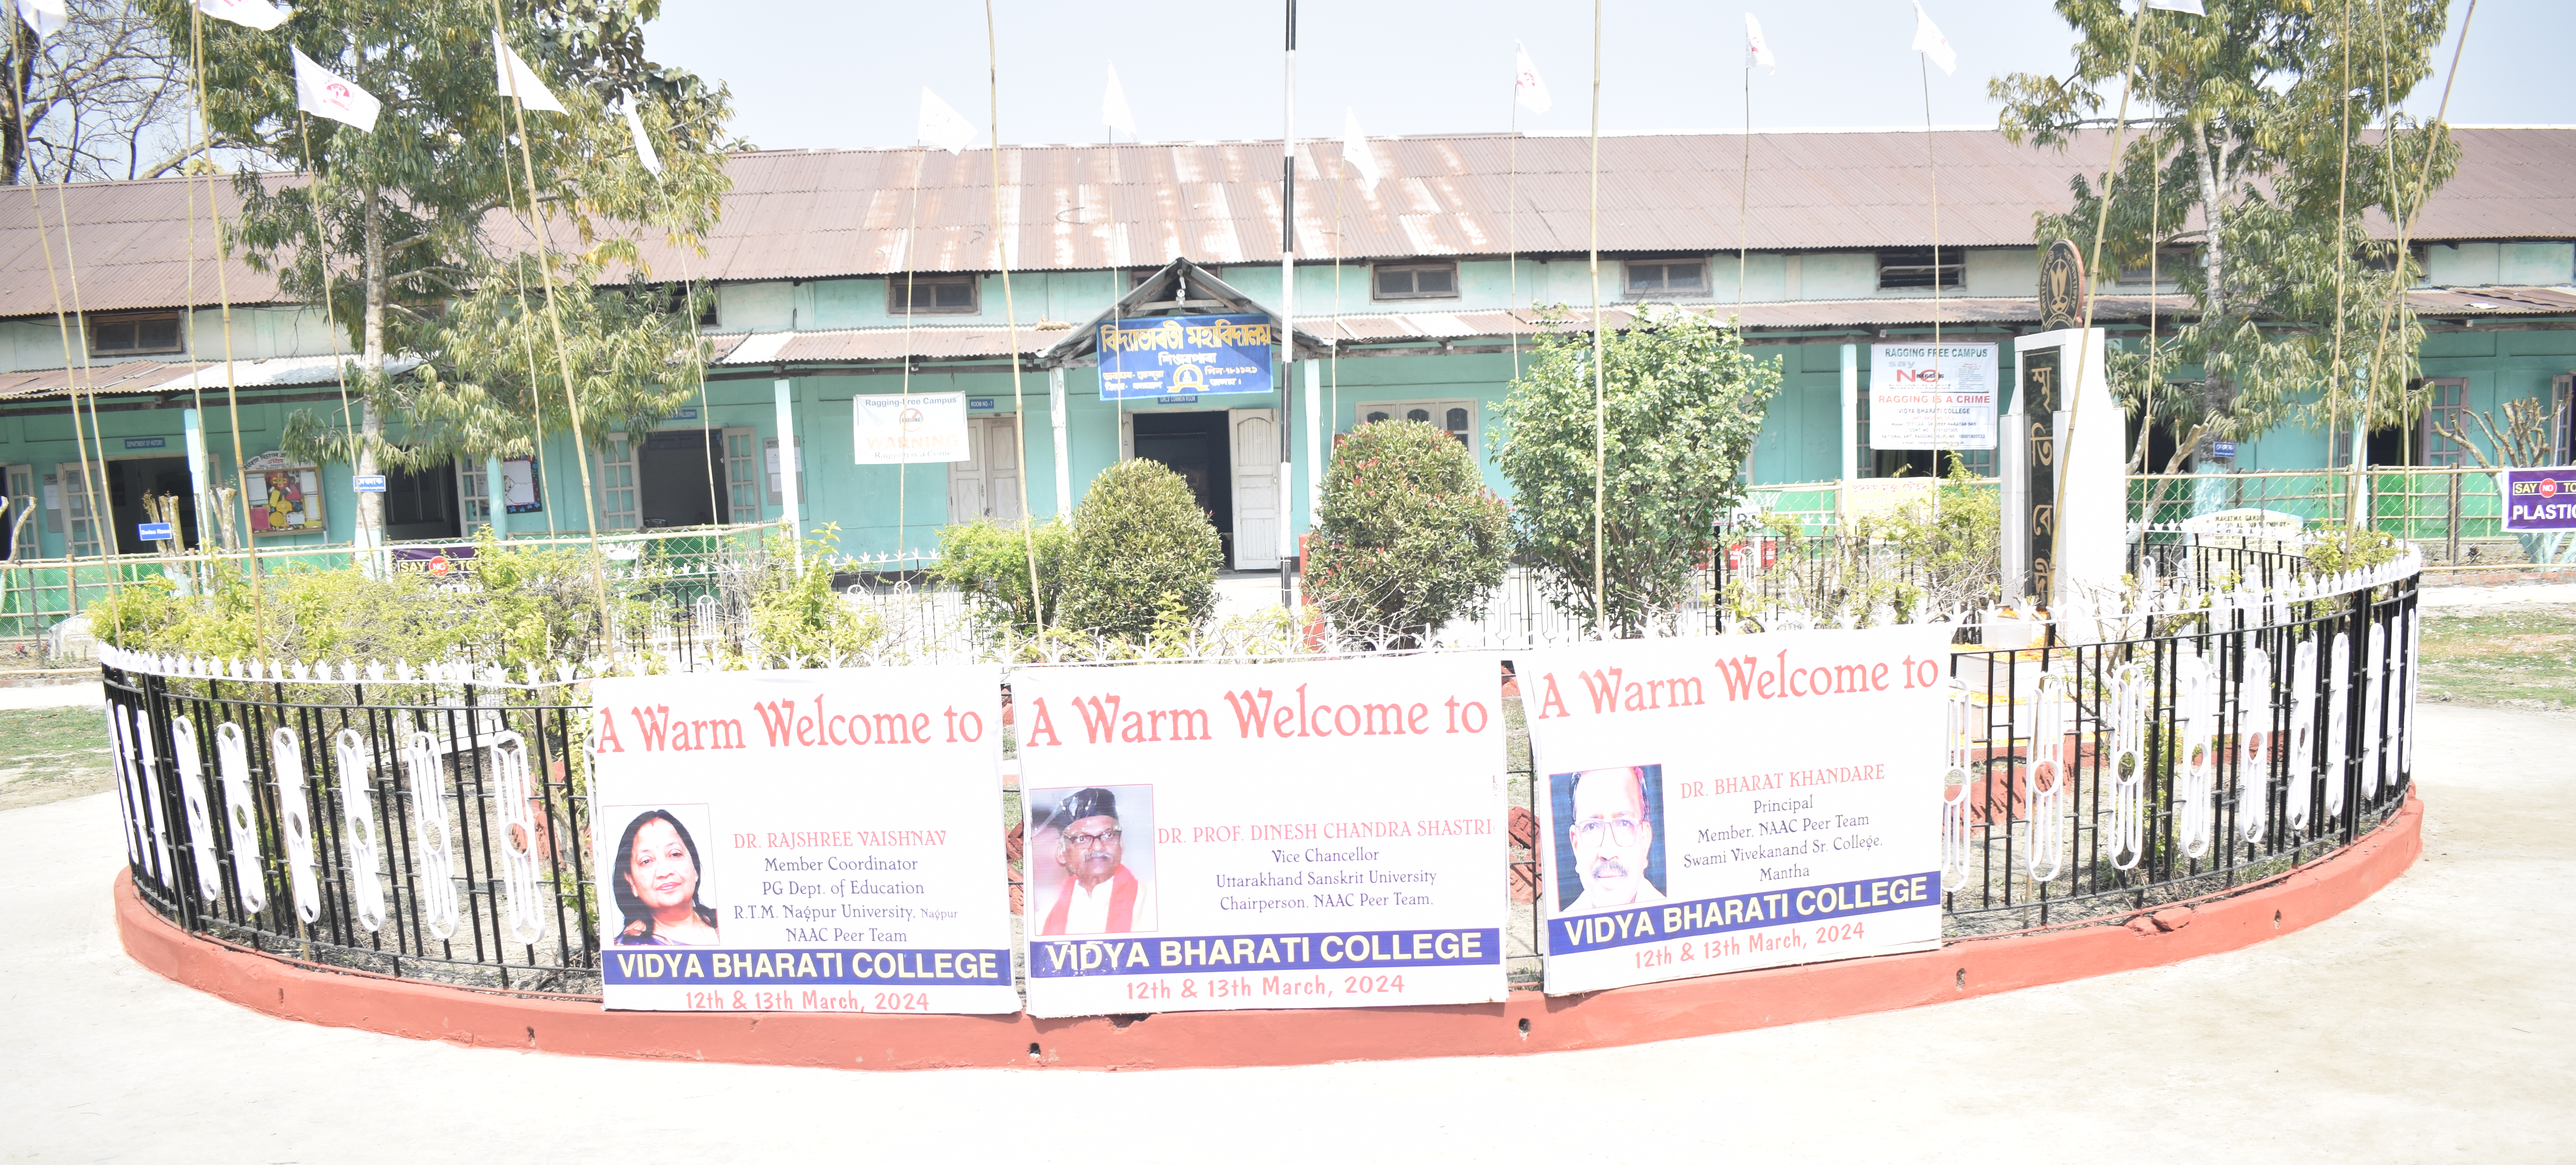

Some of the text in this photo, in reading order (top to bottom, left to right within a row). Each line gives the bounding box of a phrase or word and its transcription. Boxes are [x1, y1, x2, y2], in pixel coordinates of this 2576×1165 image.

[1885, 348, 1987, 357] RAGGING FREE CAMPUS
[923, 397, 957, 405] Campus
[867, 434, 958, 449] WARNING
[2515, 483, 2537, 494] SAY
[2564, 482, 2576, 492] TO
[401, 561, 426, 573] SAY
[1539, 649, 1938, 719] A Warm Welcome to
[597, 694, 982, 753] A Warm Welcome to
[1027, 683, 1488, 747] A Warm Welcome to
[1681, 764, 1884, 798] DR. BHARAT KHANDARE
[1753, 794, 1813, 813] Principal
[1158, 819, 1492, 843] DR. PROF. DINESH CHANDRA SHASTRI
[1759, 819, 1798, 835] NAAC
[1803, 818, 1830, 831] Peer
[1835, 814, 1869, 827] Team
[733, 830, 946, 849] DR. RAJSHREE VAISHNAV
[765, 855, 917, 871] Member Coordinator
[1271, 846, 1379, 862] Vice Chancellor
[1684, 851, 1726, 868] Swami
[1731, 840, 1807, 861] Vivekanand
[1813, 840, 1828, 853] Sr.
[1216, 870, 1436, 887] Uttarakhand Sanskrit University
[1760, 863, 1810, 881] Mantha
[762, 879, 924, 898] PG Dept. of Education
[1313, 893, 1354, 907] NAAC
[1360, 893, 1388, 906] Peer
[734, 904, 958, 922] R.T.M. Nagpur University, Nagpur
[1564, 877, 1927, 946] VIDYA BHARATI COLLEGE
[786, 928, 907, 941] NAAC Peer Team
[1046, 932, 1482, 971] VIDYA BHARATI COLLEGE
[1635, 922, 1864, 968] 12th & 13th March, 2024
[617, 953, 998, 978] VIDYA BHARATI COLLEGE
[1127, 975, 1404, 999] 12th & 13th March, 2024
[686, 990, 929, 1012] 12th & 13th March, 2024
